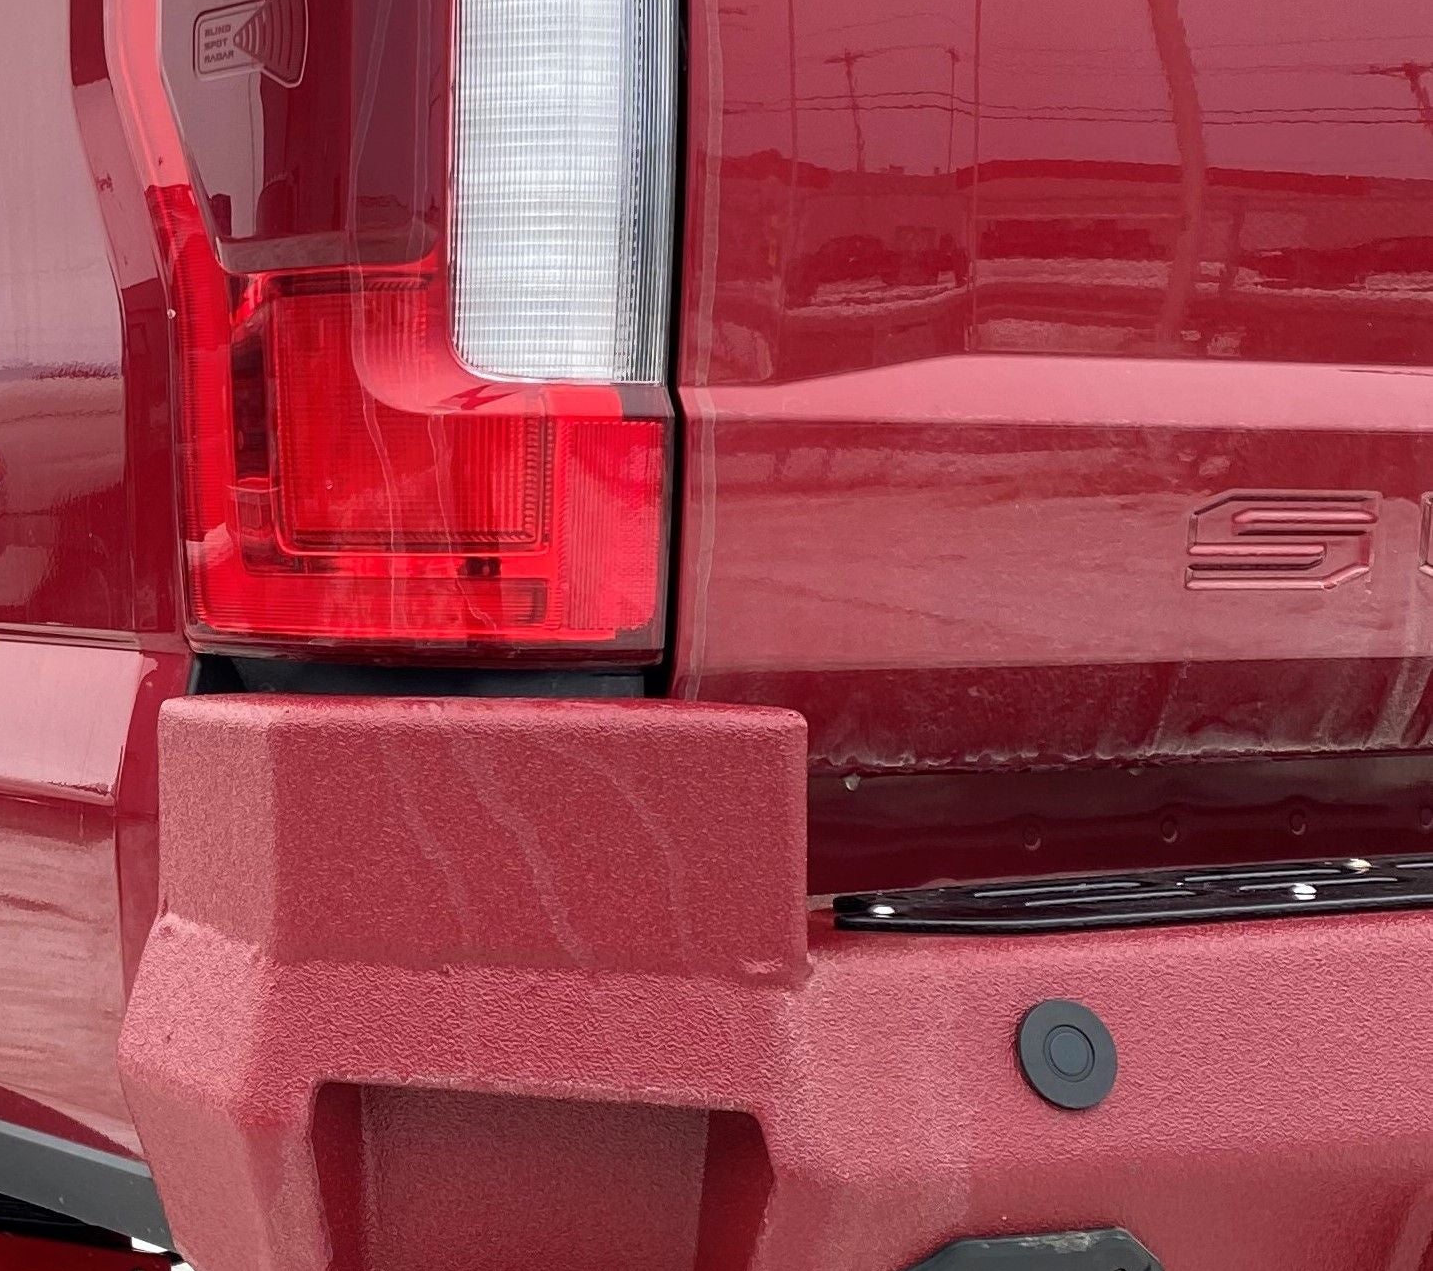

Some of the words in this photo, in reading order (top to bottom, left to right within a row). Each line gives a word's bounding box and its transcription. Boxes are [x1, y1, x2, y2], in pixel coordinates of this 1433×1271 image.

[204, 24, 231, 37] BLIND
[204, 38, 228, 50] SPOT
[204, 50, 234, 64] RADAR
[1184, 488, 1433, 591] S
